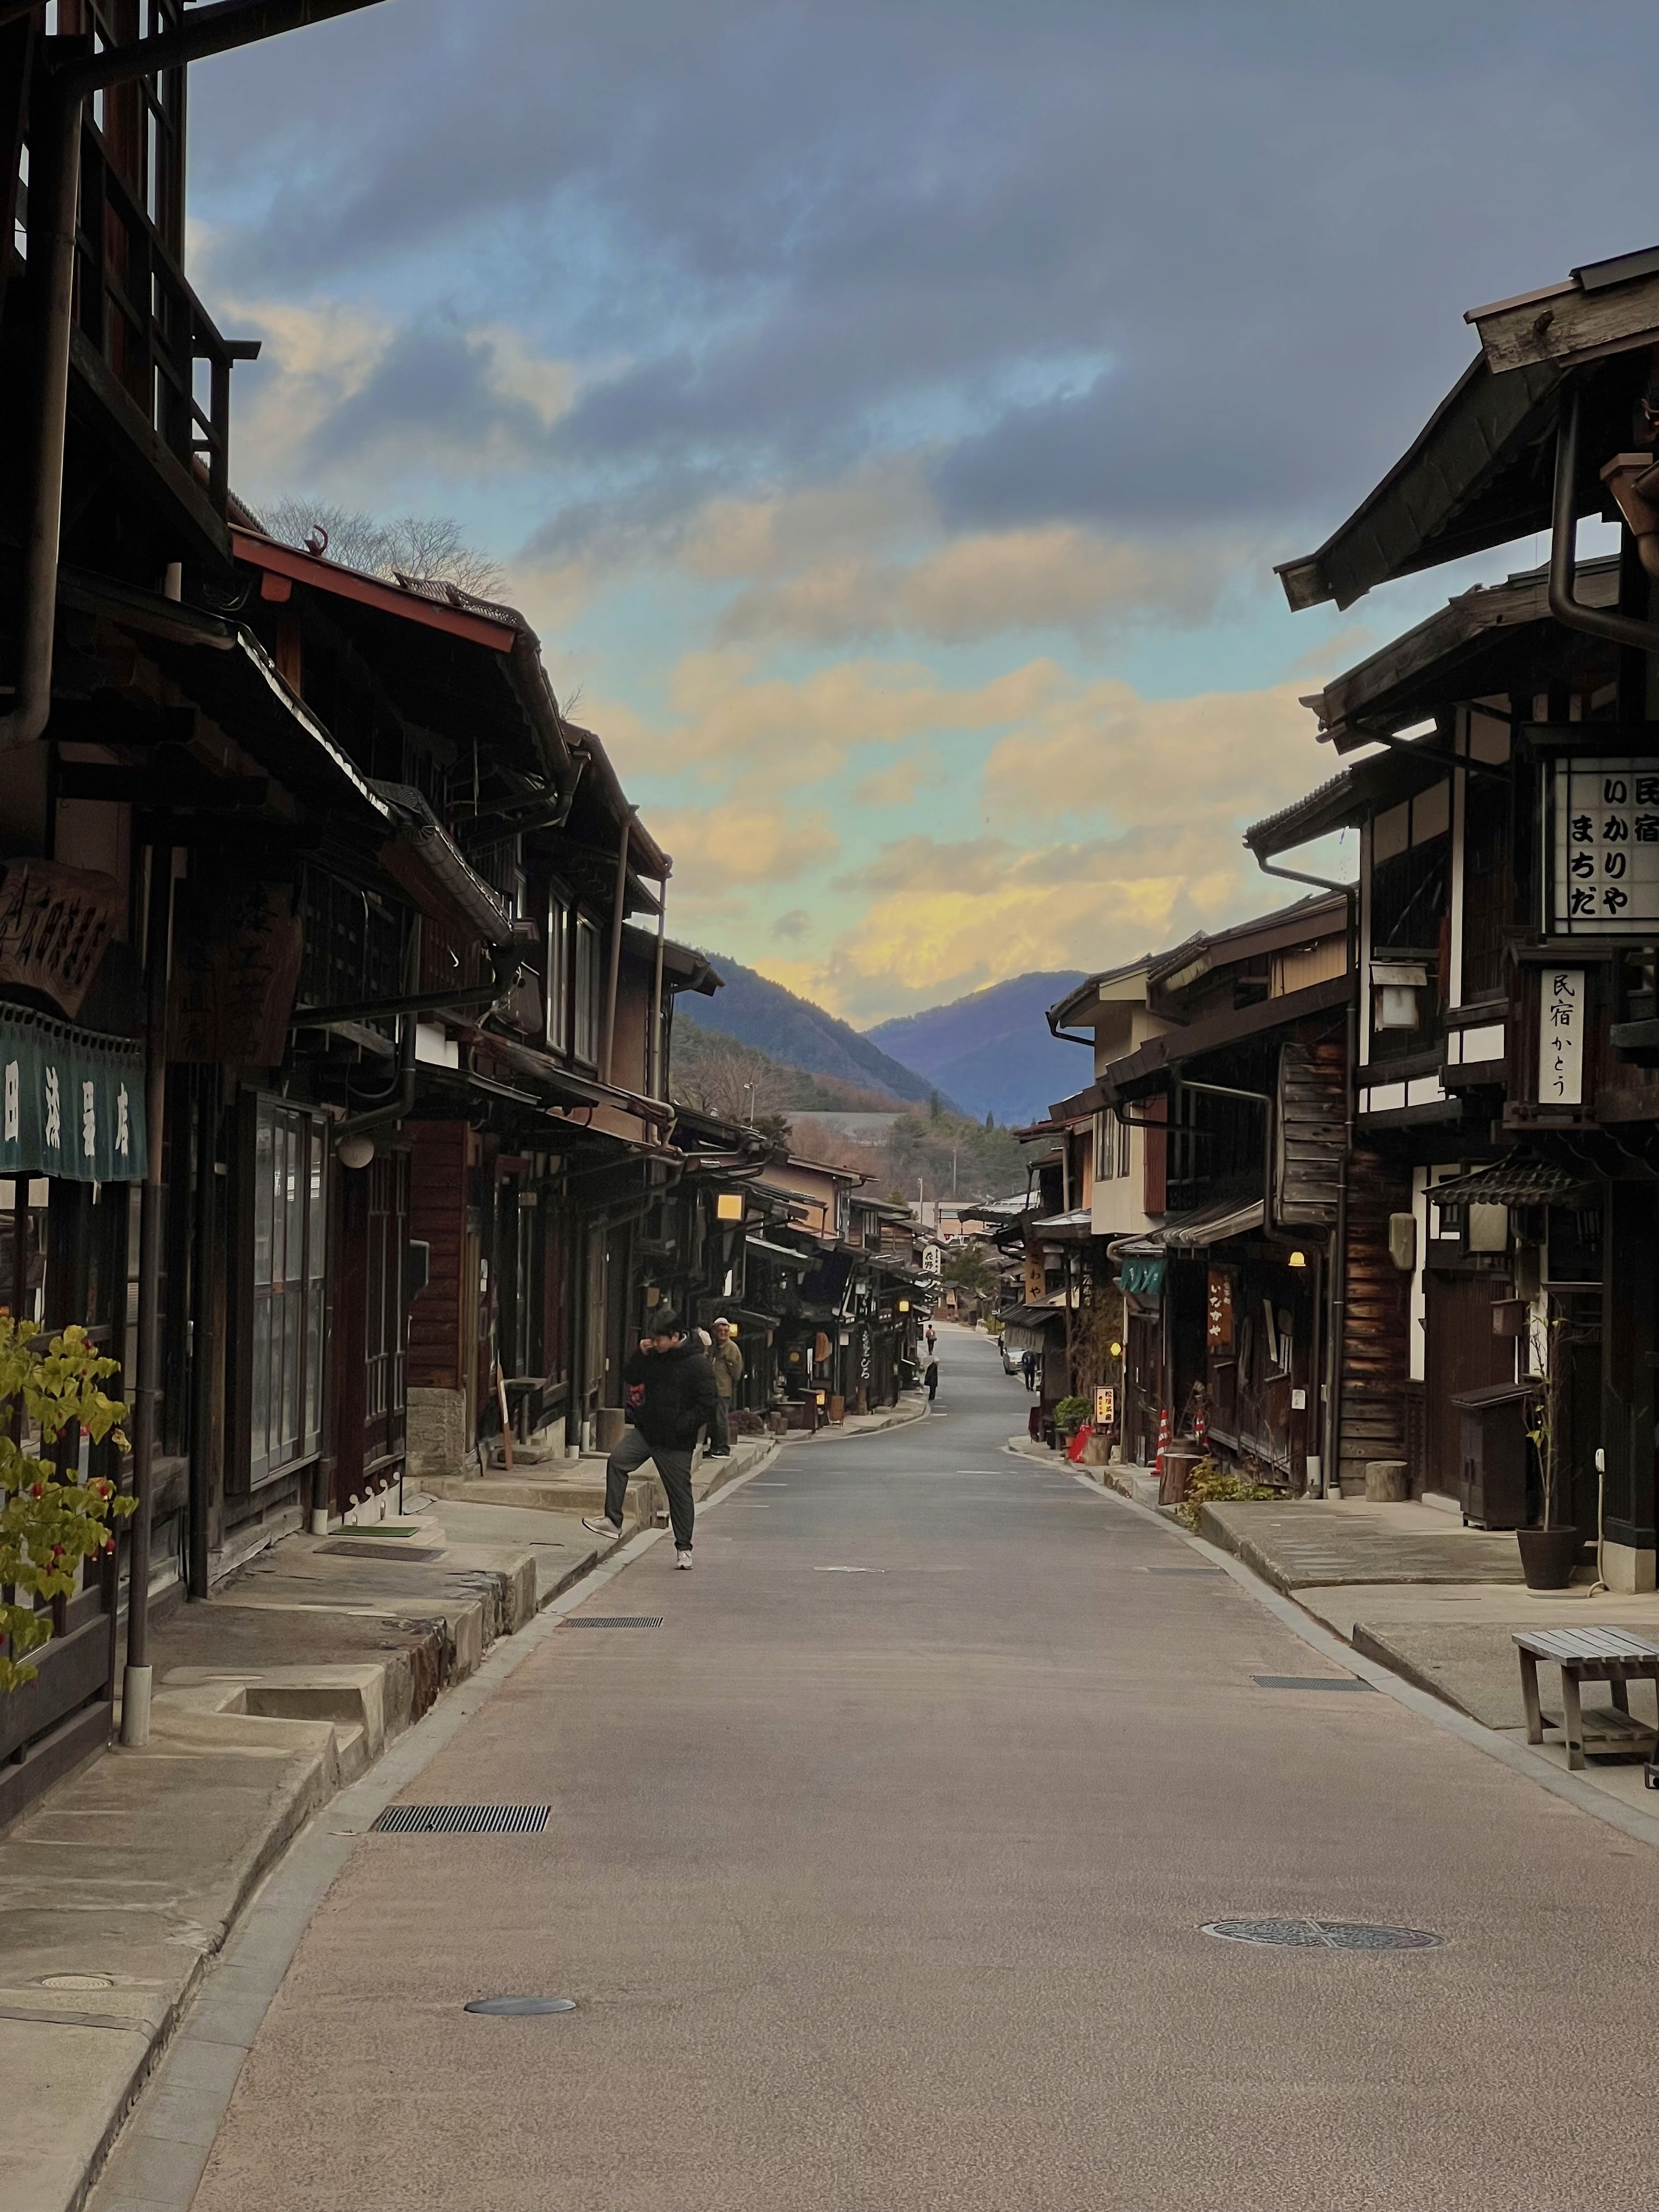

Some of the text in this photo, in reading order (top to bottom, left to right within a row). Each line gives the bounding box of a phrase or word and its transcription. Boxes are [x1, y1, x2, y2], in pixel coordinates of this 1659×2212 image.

[1602, 778, 1628, 915] いかりや
[1635, 777, 1659, 842] 民宿
[1571, 815, 1597, 915] まちだ
[1209, 1284, 1222, 1336] いなかや
